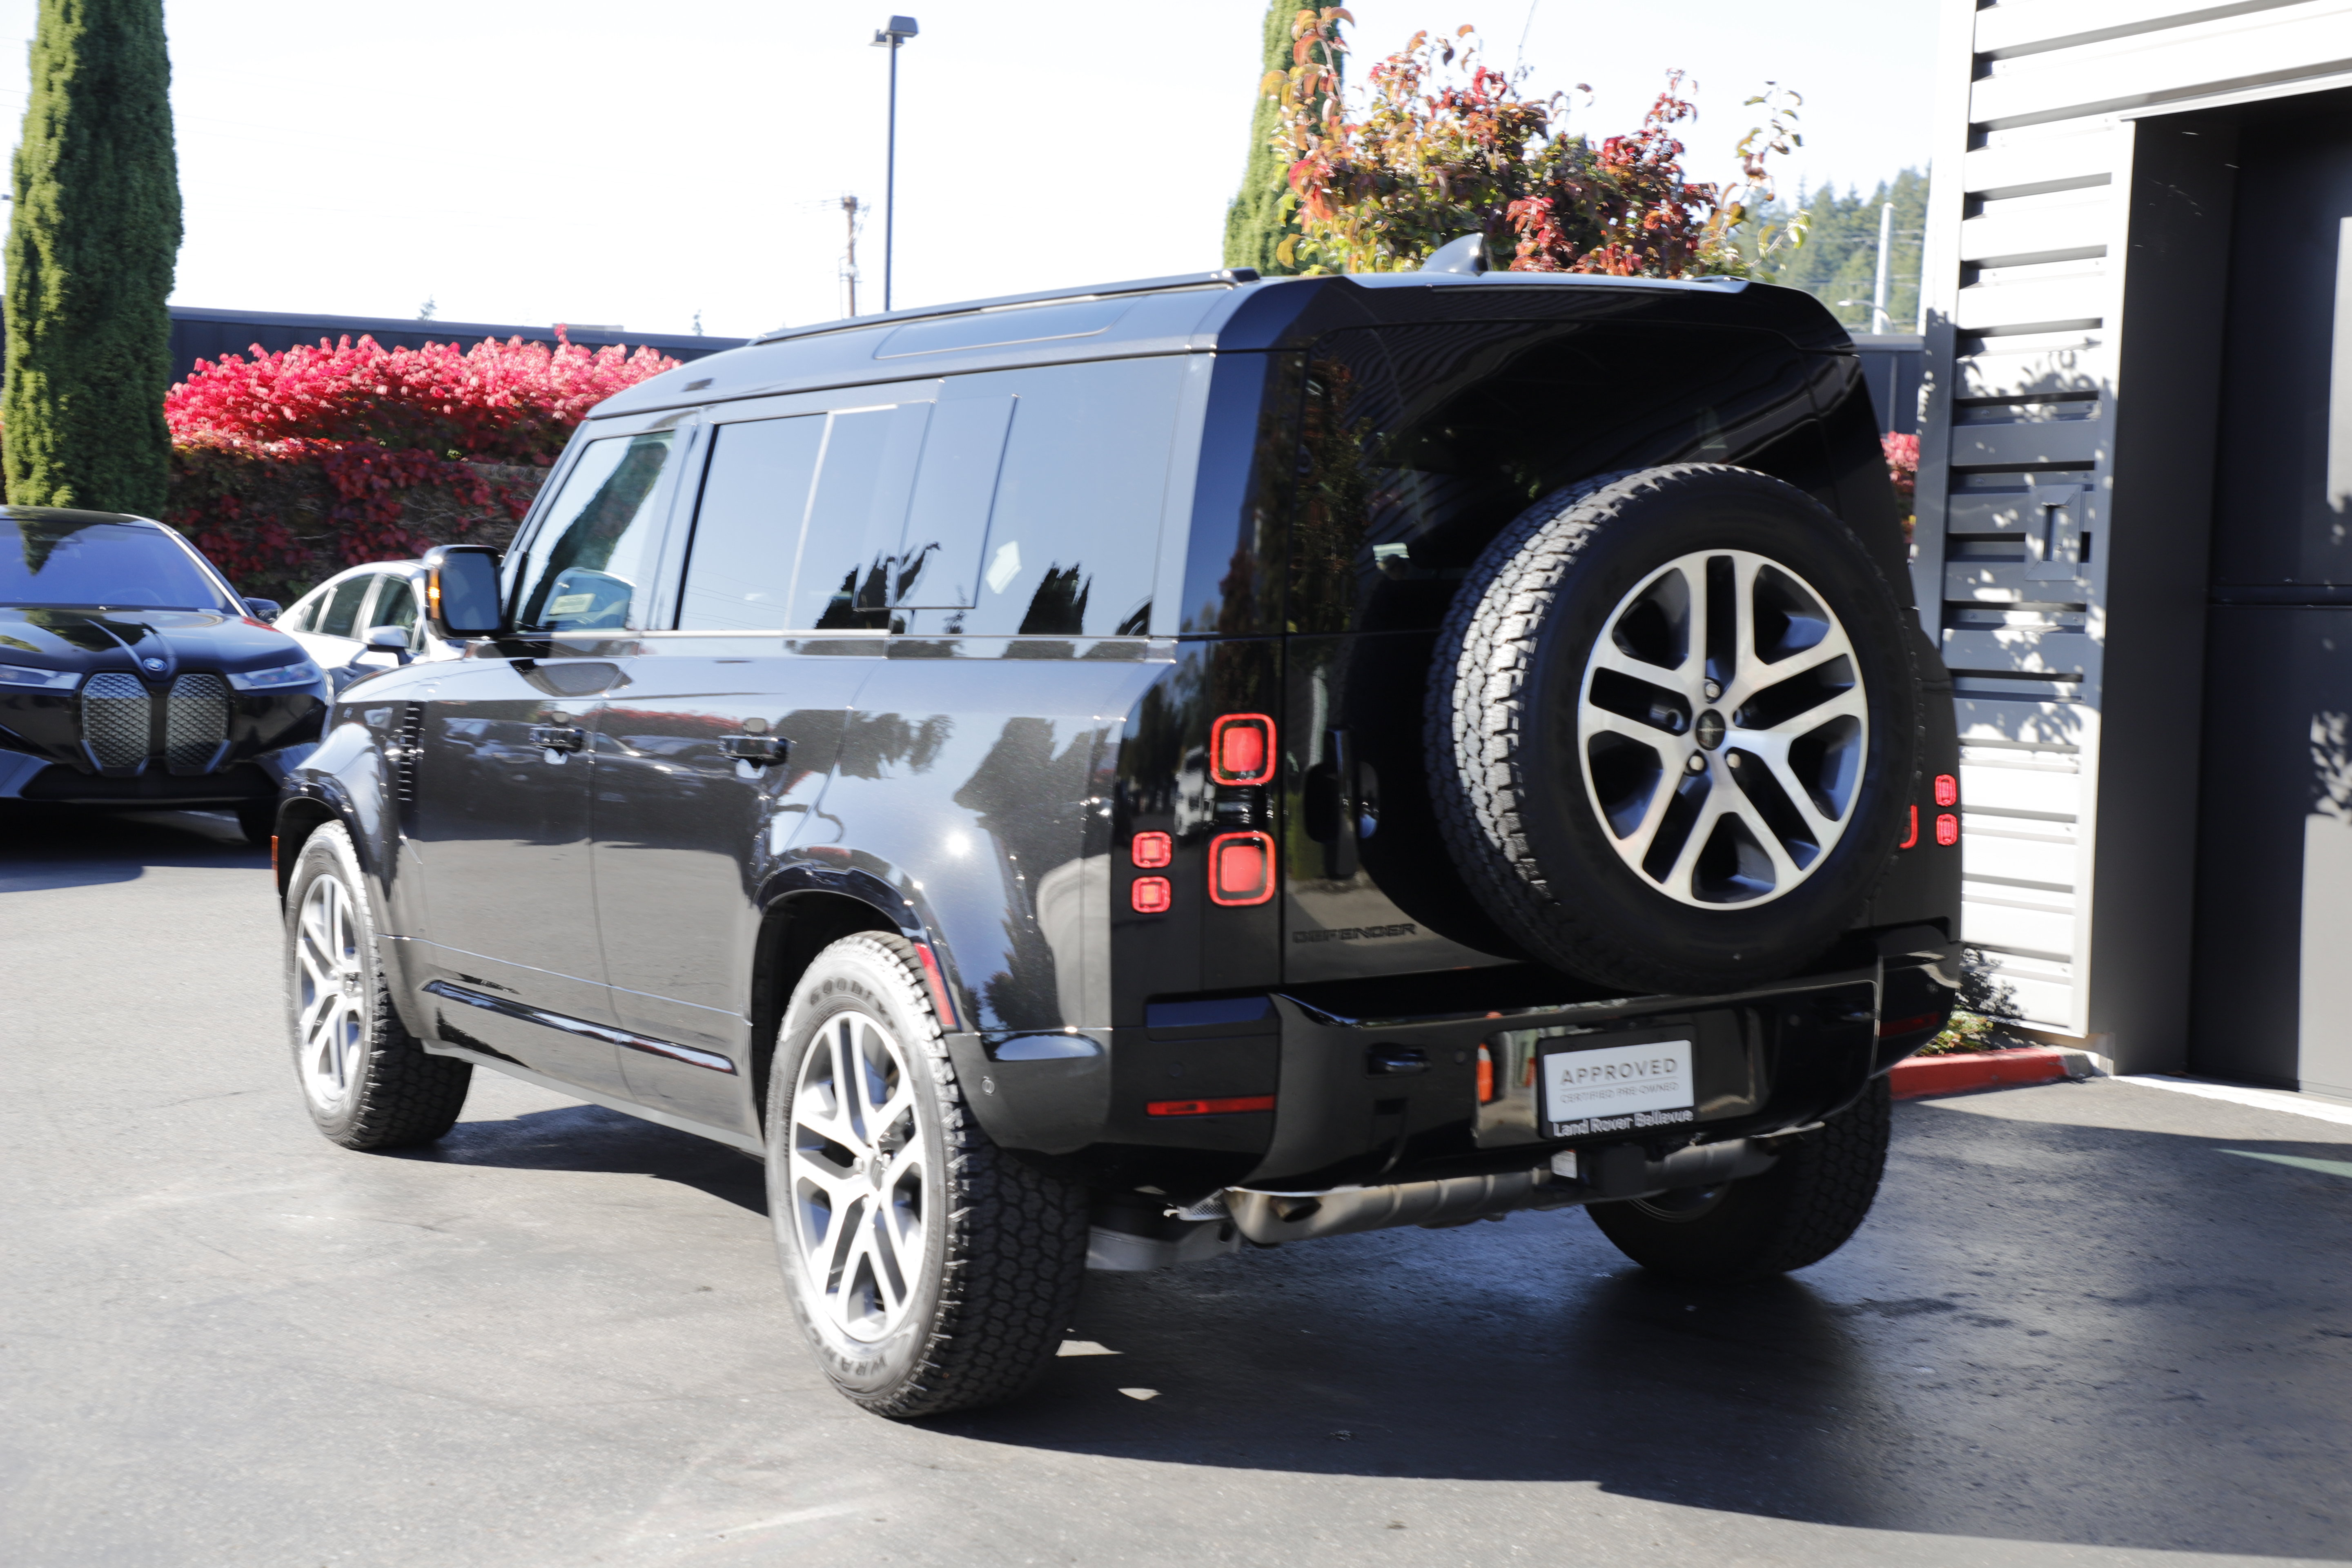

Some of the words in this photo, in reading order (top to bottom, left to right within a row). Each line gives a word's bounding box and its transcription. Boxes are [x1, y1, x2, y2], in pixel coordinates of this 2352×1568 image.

[1292, 923, 1417, 943] DEFENDER
[1560, 1058, 1678, 1085] APPROVED
[1559, 1089, 1615, 1104] CERTIFIED
[1553, 1119, 1589, 1138] Land
[1590, 1117, 1633, 1133] Rover
[1634, 1109, 1694, 1128] Bellevue
